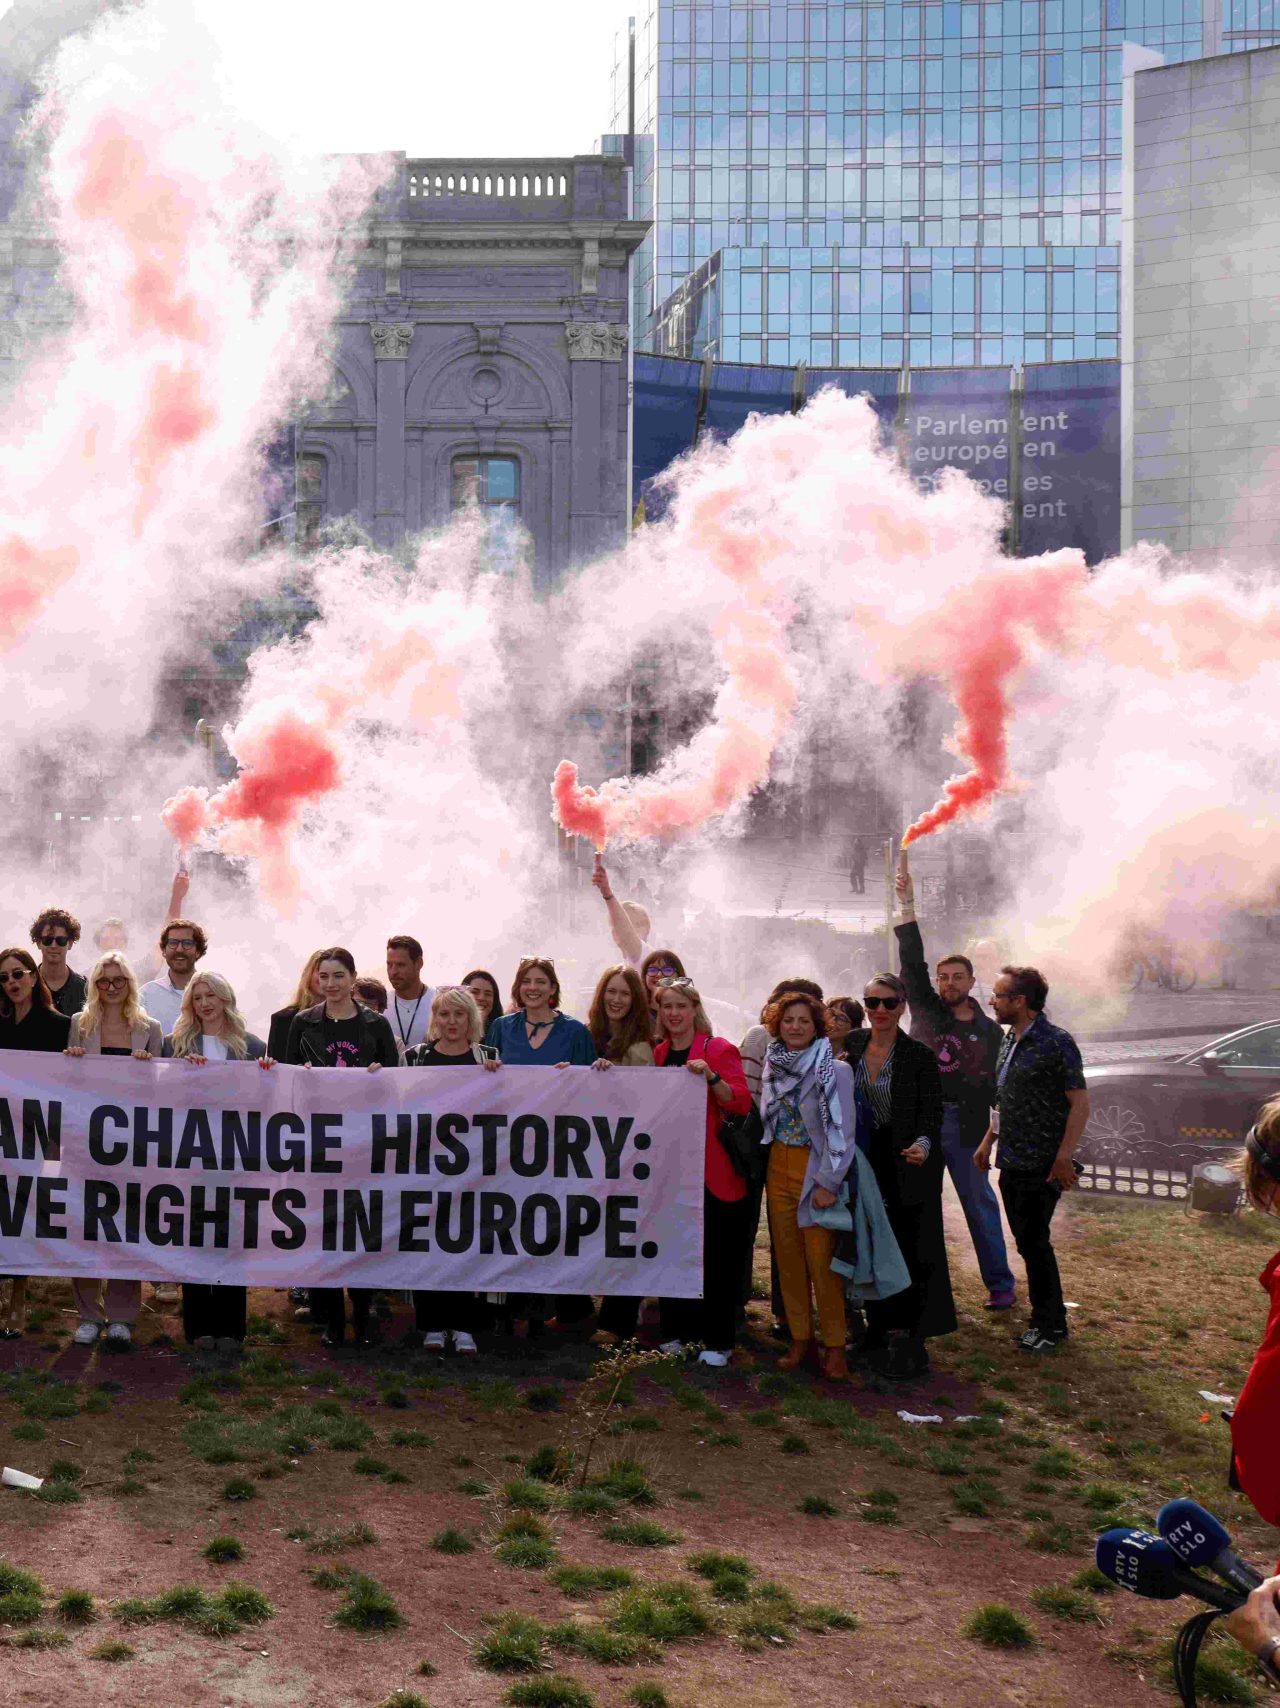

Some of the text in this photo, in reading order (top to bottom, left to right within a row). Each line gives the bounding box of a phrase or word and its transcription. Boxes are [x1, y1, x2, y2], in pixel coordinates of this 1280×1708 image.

[325, 1040, 359, 1055] MY VOICE
[88, 1104, 343, 1175] CHANGE
[370, 1112, 652, 1181] HISTORY:
[83, 1178, 307, 1250] RIGHTS
[321, 1188, 383, 1253] IN
[397, 1189, 659, 1259] EUROPE.
[1168, 1520, 1193, 1544] RTV
[1179, 1532, 1206, 1556] SLO
[1115, 1550, 1126, 1576] RTV
[1127, 1556, 1139, 1581] SLO
